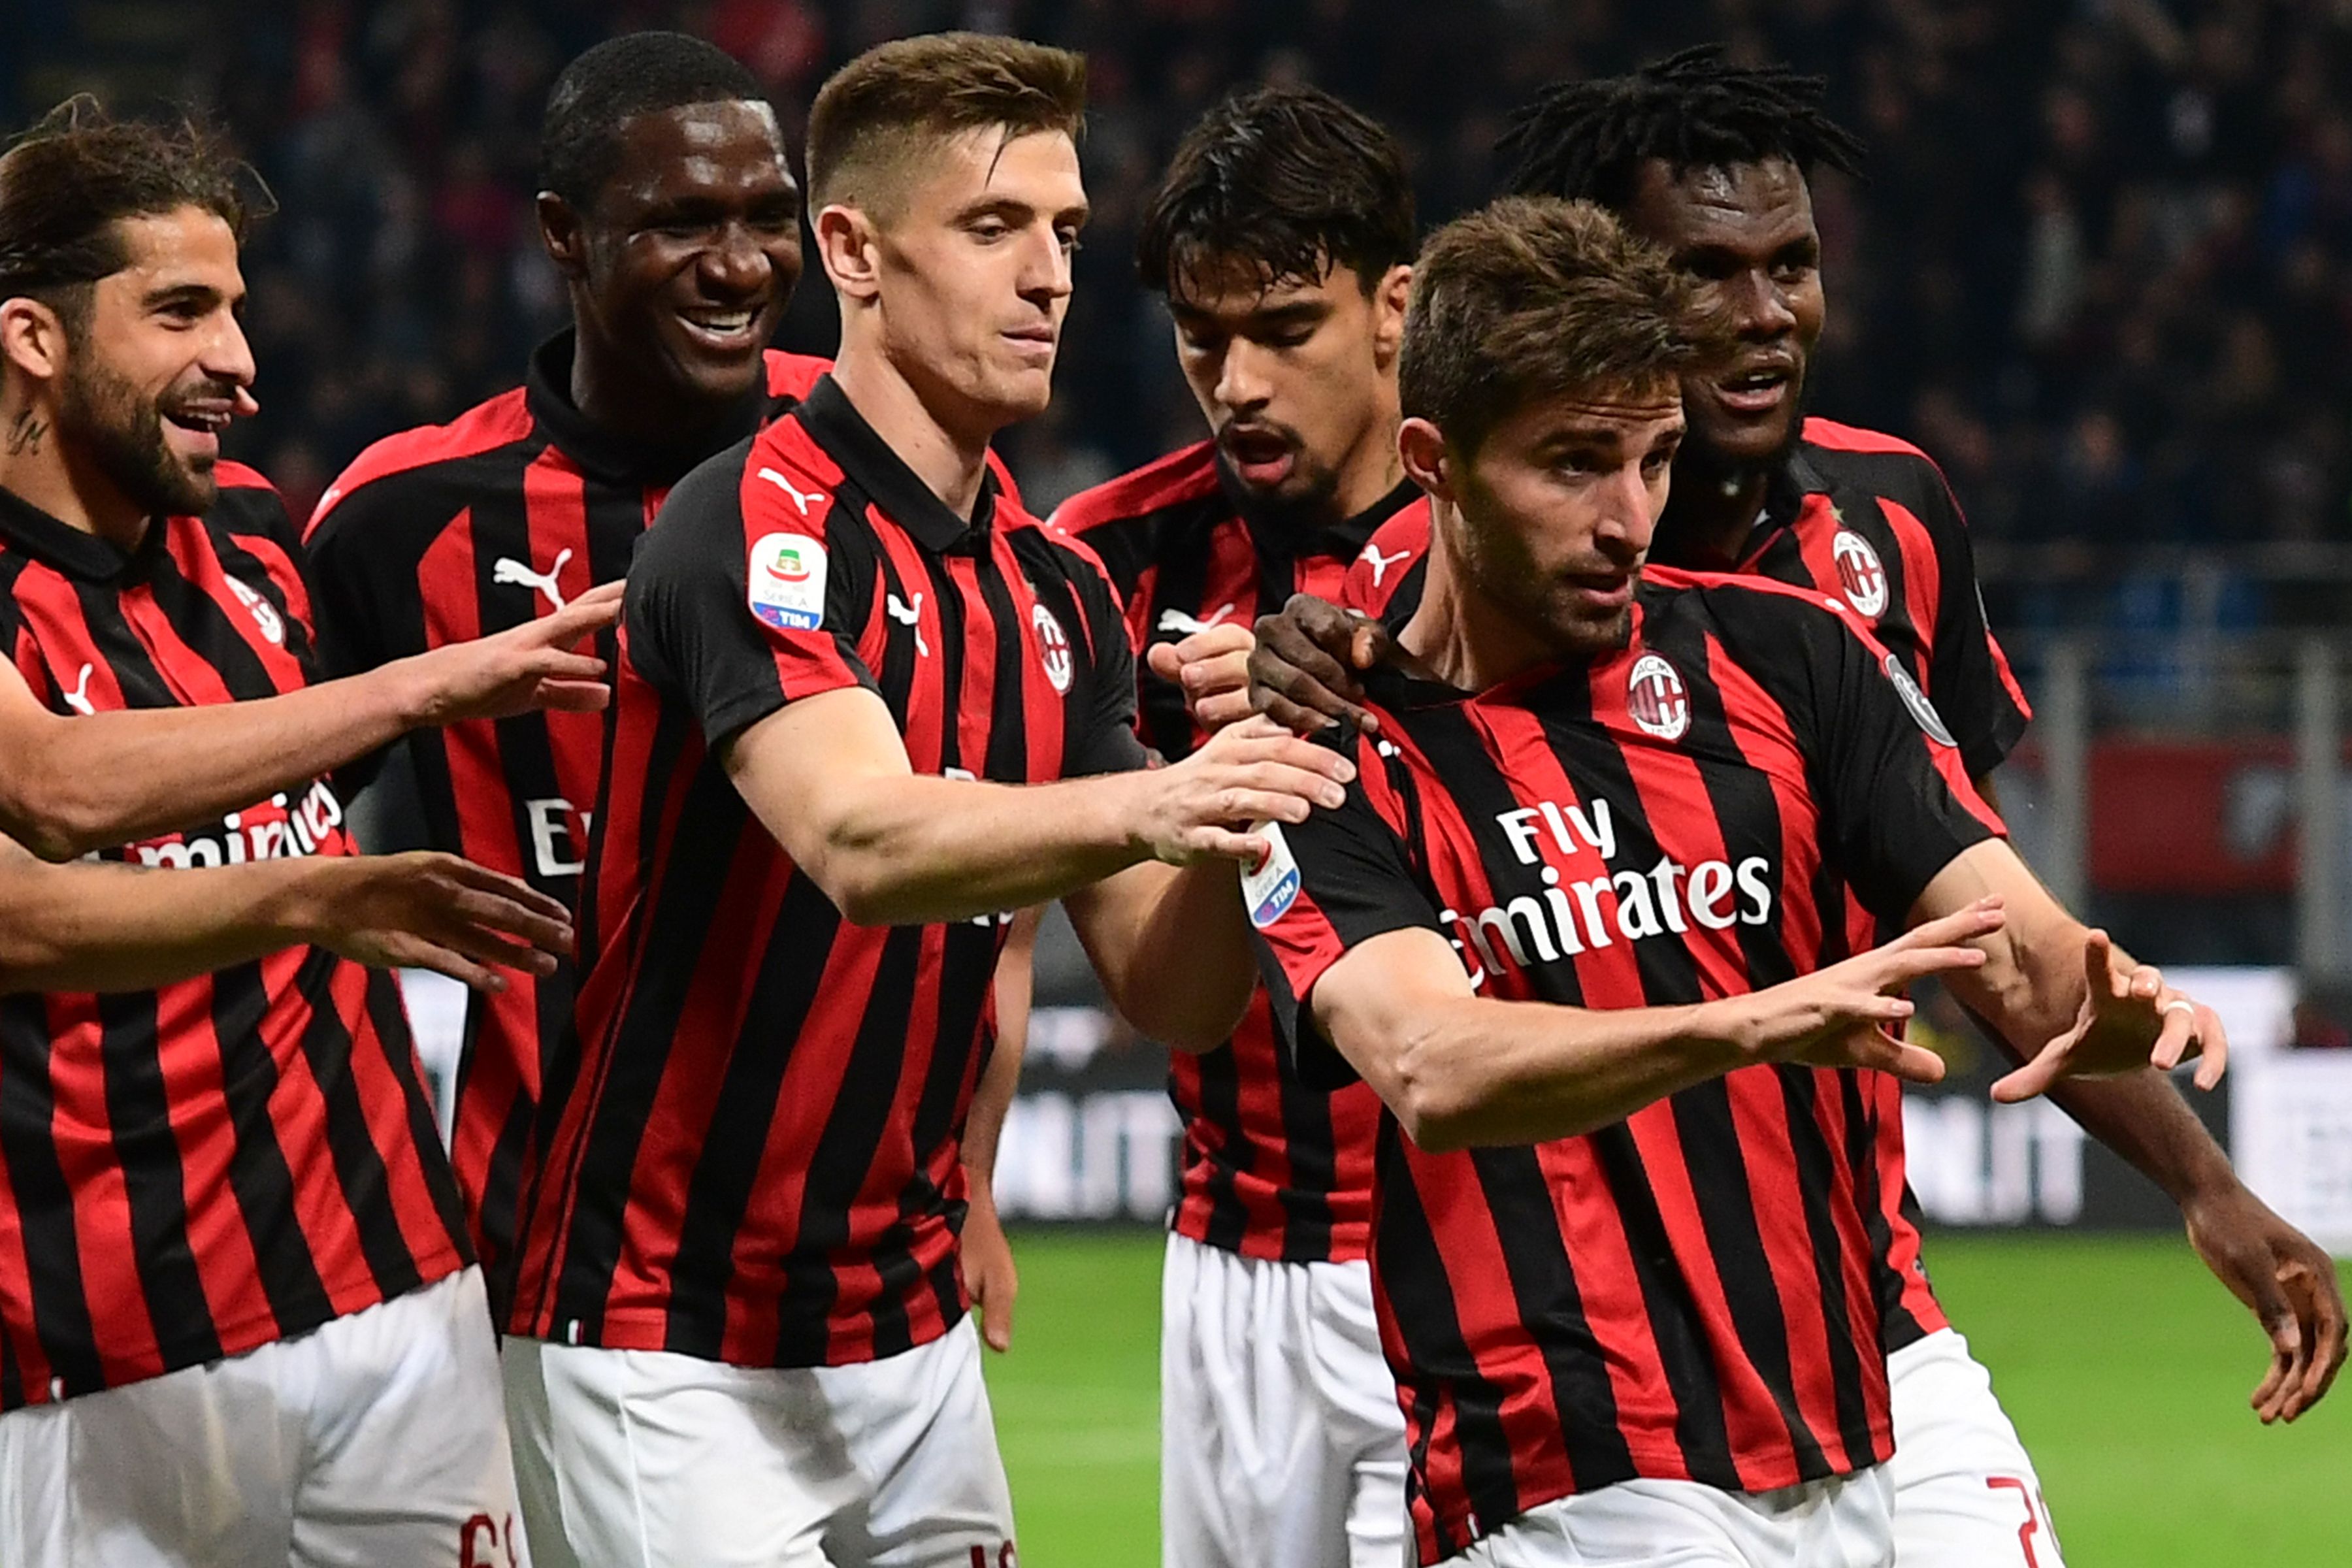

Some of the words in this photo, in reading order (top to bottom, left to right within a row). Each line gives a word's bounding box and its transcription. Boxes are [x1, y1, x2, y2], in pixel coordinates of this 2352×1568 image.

[779, 610, 810, 629] TIM
[1636, 659, 1670, 678] ACM
[1495, 798, 1616, 864] Fly
[1270, 879, 1294, 908] TIM
